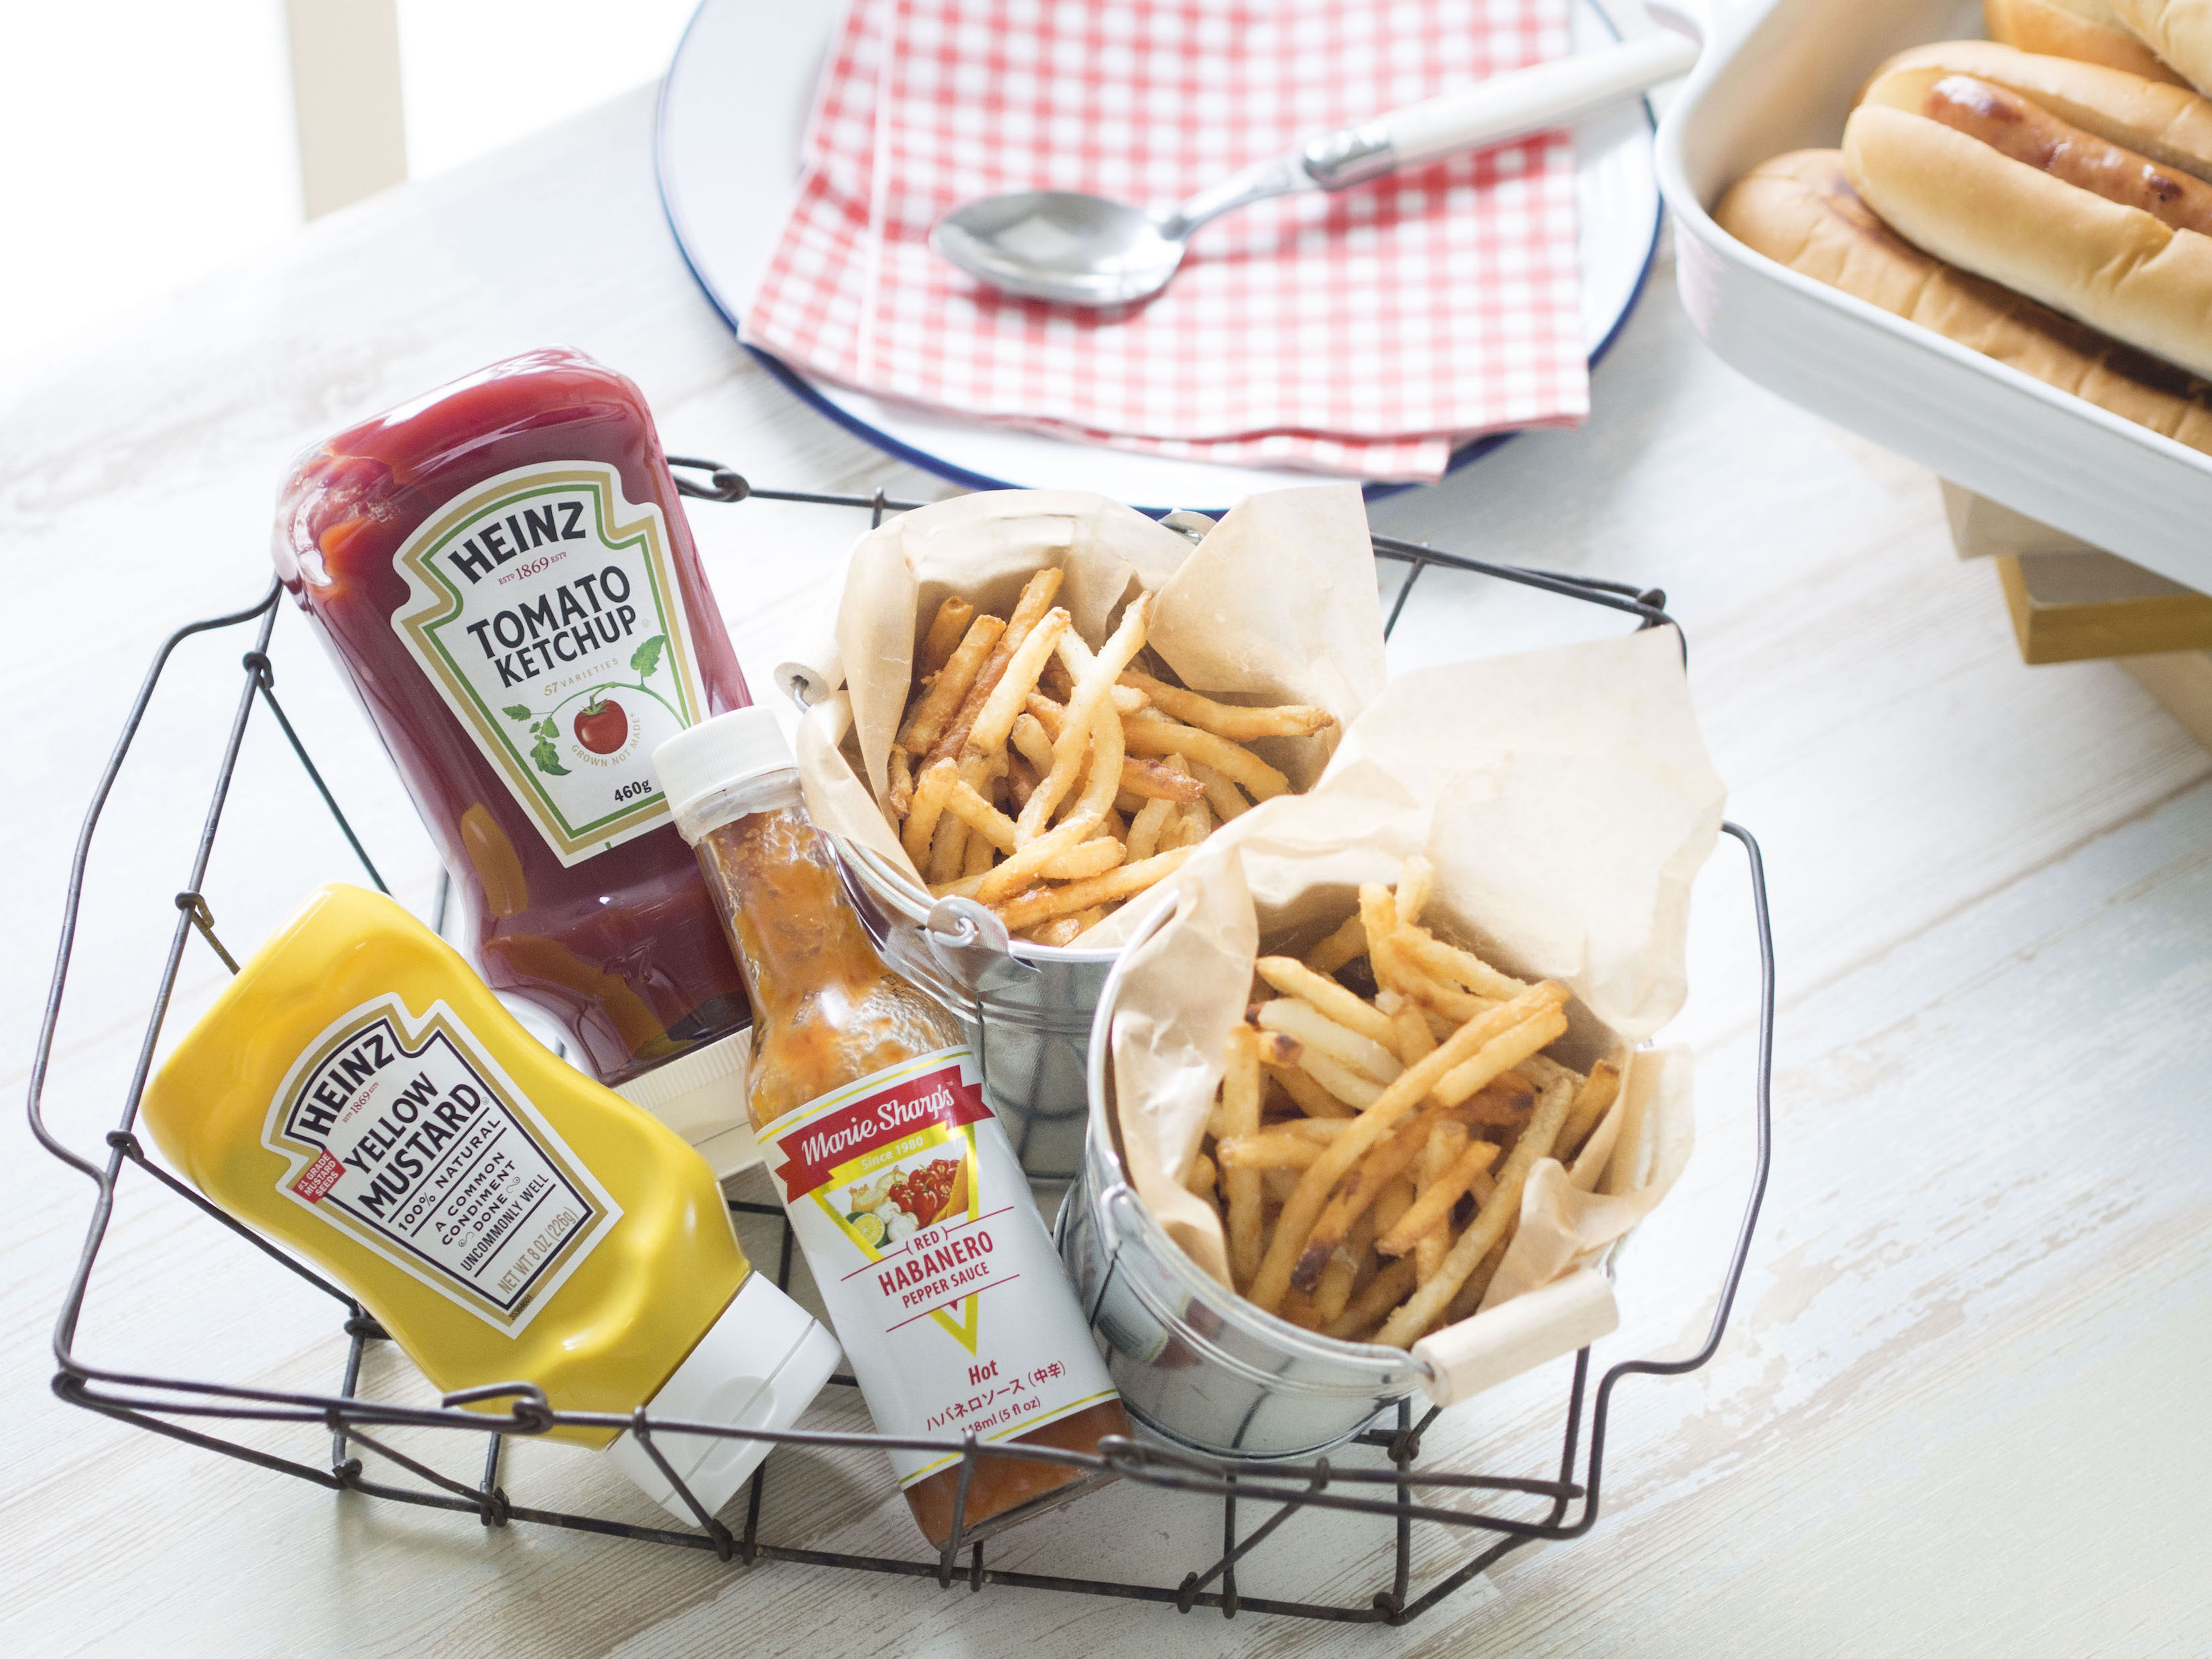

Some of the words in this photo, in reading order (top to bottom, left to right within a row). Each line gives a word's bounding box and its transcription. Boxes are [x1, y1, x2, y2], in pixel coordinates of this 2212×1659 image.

[447, 501, 586, 585] HEINZ
[515, 556, 549, 580] 1869
[466, 565, 631, 660] TOMATO
[493, 605, 636, 688] KETCHUP
[544, 681, 559, 696] 57
[560, 658, 619, 687] VARIETIES
[571, 744, 608, 767] GROWN
[611, 749, 631, 765] NOT
[614, 779, 652, 802] 460g
[298, 1033, 395, 1137] HEINZ
[350, 1091, 371, 1115] 1869
[343, 1070, 439, 1174] YELLOW
[801, 1117, 877, 1166] Marie
[877, 1084, 955, 1131] Sharp's
[357, 1083, 481, 1220] MUSTARD
[860, 1150, 893, 1171] Since
[895, 1135, 924, 1156] 1980
[297, 1179, 309, 1191] #1
[306, 1153, 331, 1180] GRADE
[304, 1160, 336, 1196] MUSTARD
[315, 1170, 339, 1196] SEEDS
[398, 1192, 436, 1231] 100%
[434, 1119, 501, 1189] NATURAL
[435, 1221, 446, 1233] A
[447, 1151, 505, 1217] COMMON
[441, 1160, 515, 1245] CONDIMENT
[460, 1200, 524, 1272] UNCOMMONLY
[519, 1174, 550, 1203] WELL
[473, 1193, 508, 1232] DONE
[544, 1205, 580, 1243] (226g)
[526, 1247, 541, 1261] 8
[533, 1233, 553, 1253] OZ
[497, 1270, 521, 1295] NET
[513, 1254, 534, 1276] WT
[877, 1230, 993, 1297] HABANERO
[901, 1278, 950, 1308] PEPPER
[950, 1261, 990, 1287] SAUCE
[967, 1359, 999, 1386] Hot
[998, 1409, 1011, 1422] (5
[1011, 1403, 1022, 1416] fl
[1022, 1396, 1041, 1411] oz)
